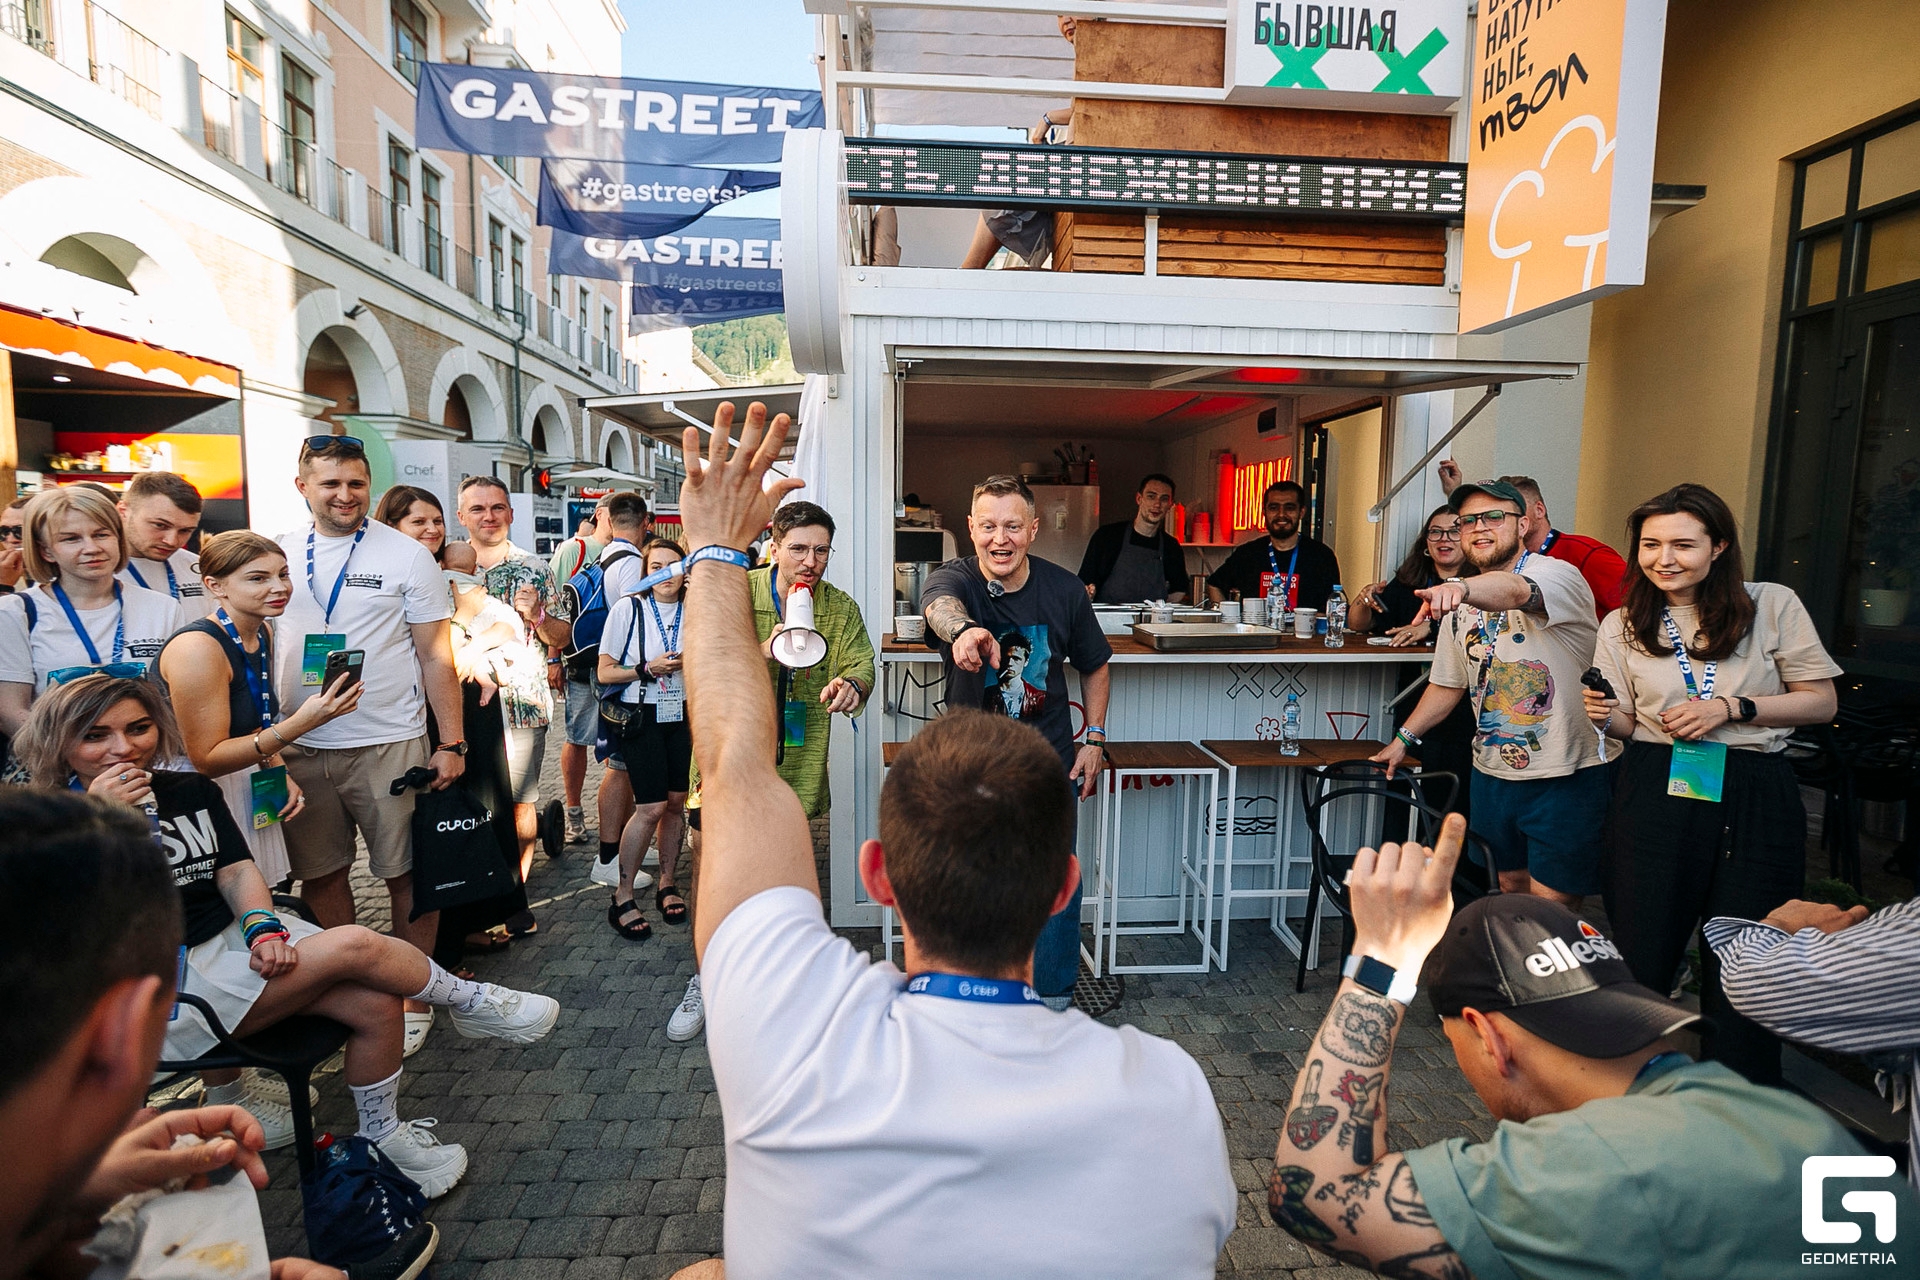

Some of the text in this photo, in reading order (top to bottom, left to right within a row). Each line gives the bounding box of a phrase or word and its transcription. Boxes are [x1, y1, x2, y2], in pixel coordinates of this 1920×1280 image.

[1254, 2, 1397, 53] БЫВШАЯ
[1482, 36, 1534, 104] НЫЕ,
[449, 78, 802, 136] GASTREET
[404, 464, 435, 476] Chef
